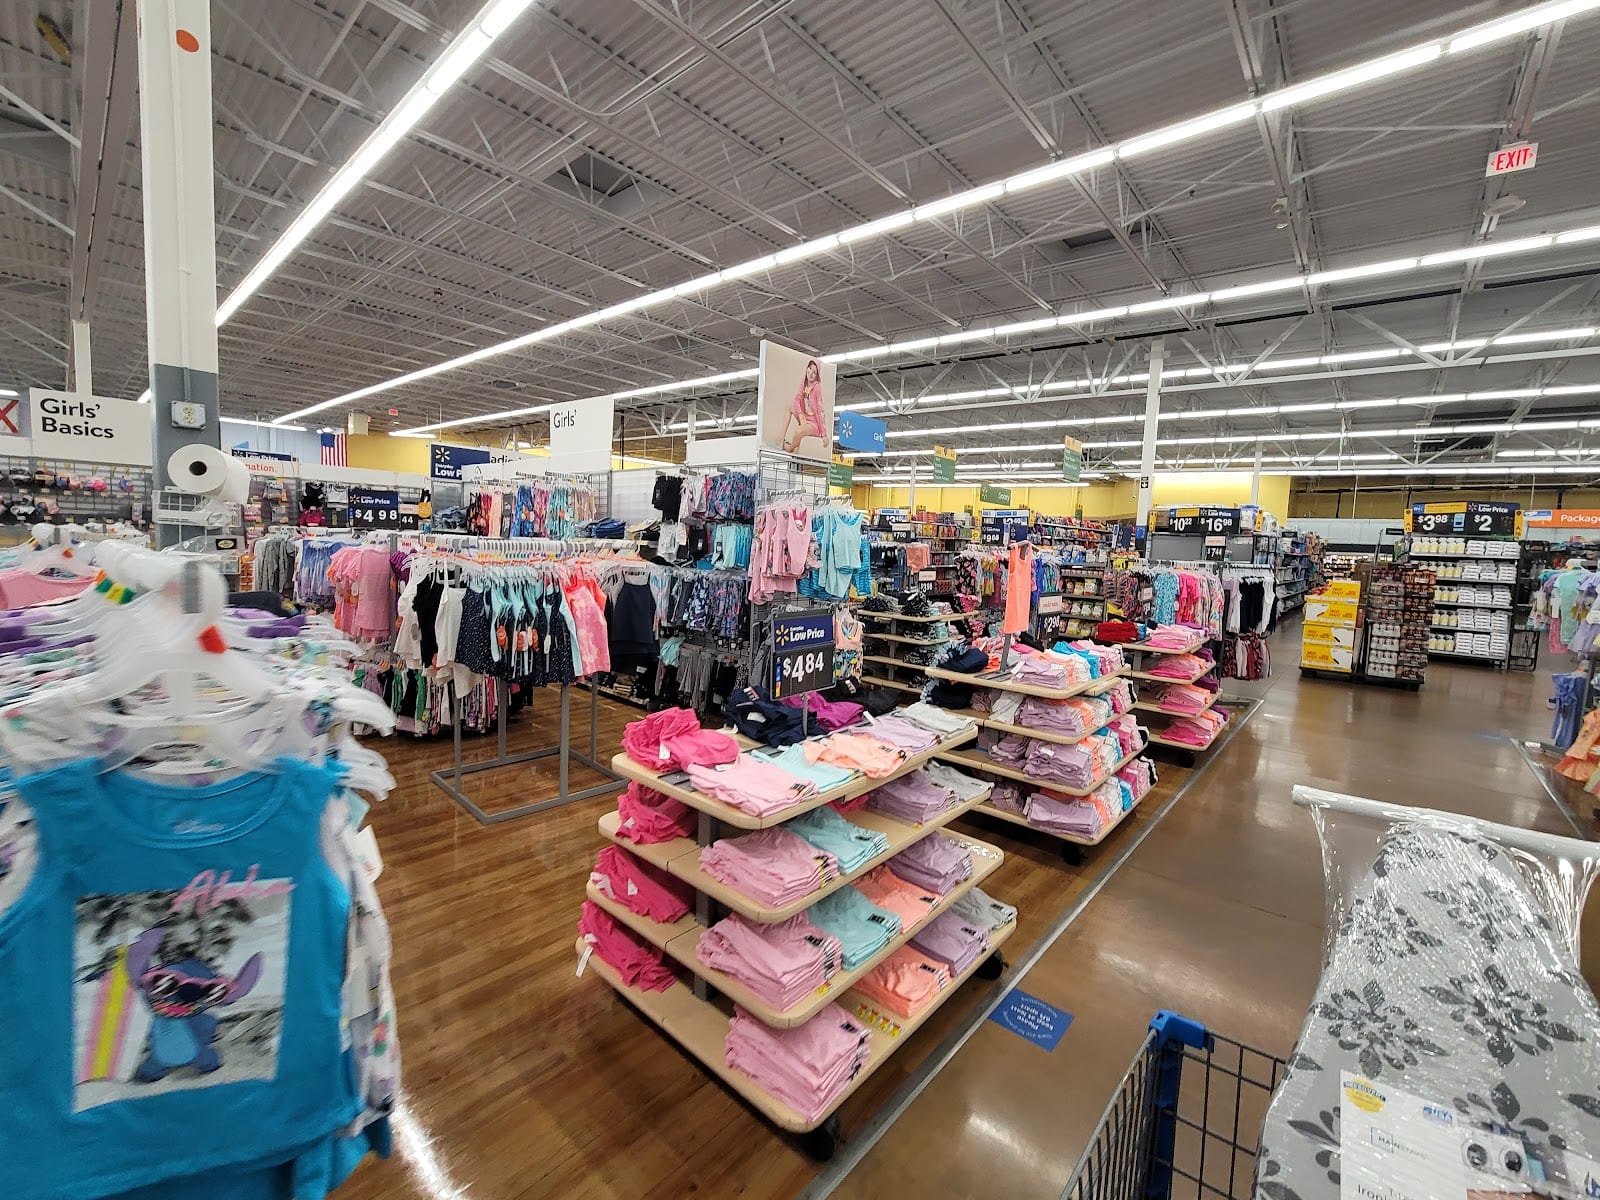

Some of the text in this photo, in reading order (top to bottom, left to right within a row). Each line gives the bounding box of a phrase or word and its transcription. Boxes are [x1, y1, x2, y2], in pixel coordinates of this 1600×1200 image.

[1496, 147, 1530, 171] EXIT
[40, 398, 101, 419] Girls'
[41, 416, 114, 439] Basics
[553, 409, 577, 428] Girls'
[434, 466, 455, 477] Low
[1200, 517, 1233, 532] $1698
[1474, 514, 1493, 532] $2
[790, 627, 825, 642] Low Price
[783, 651, 825, 683] $484
